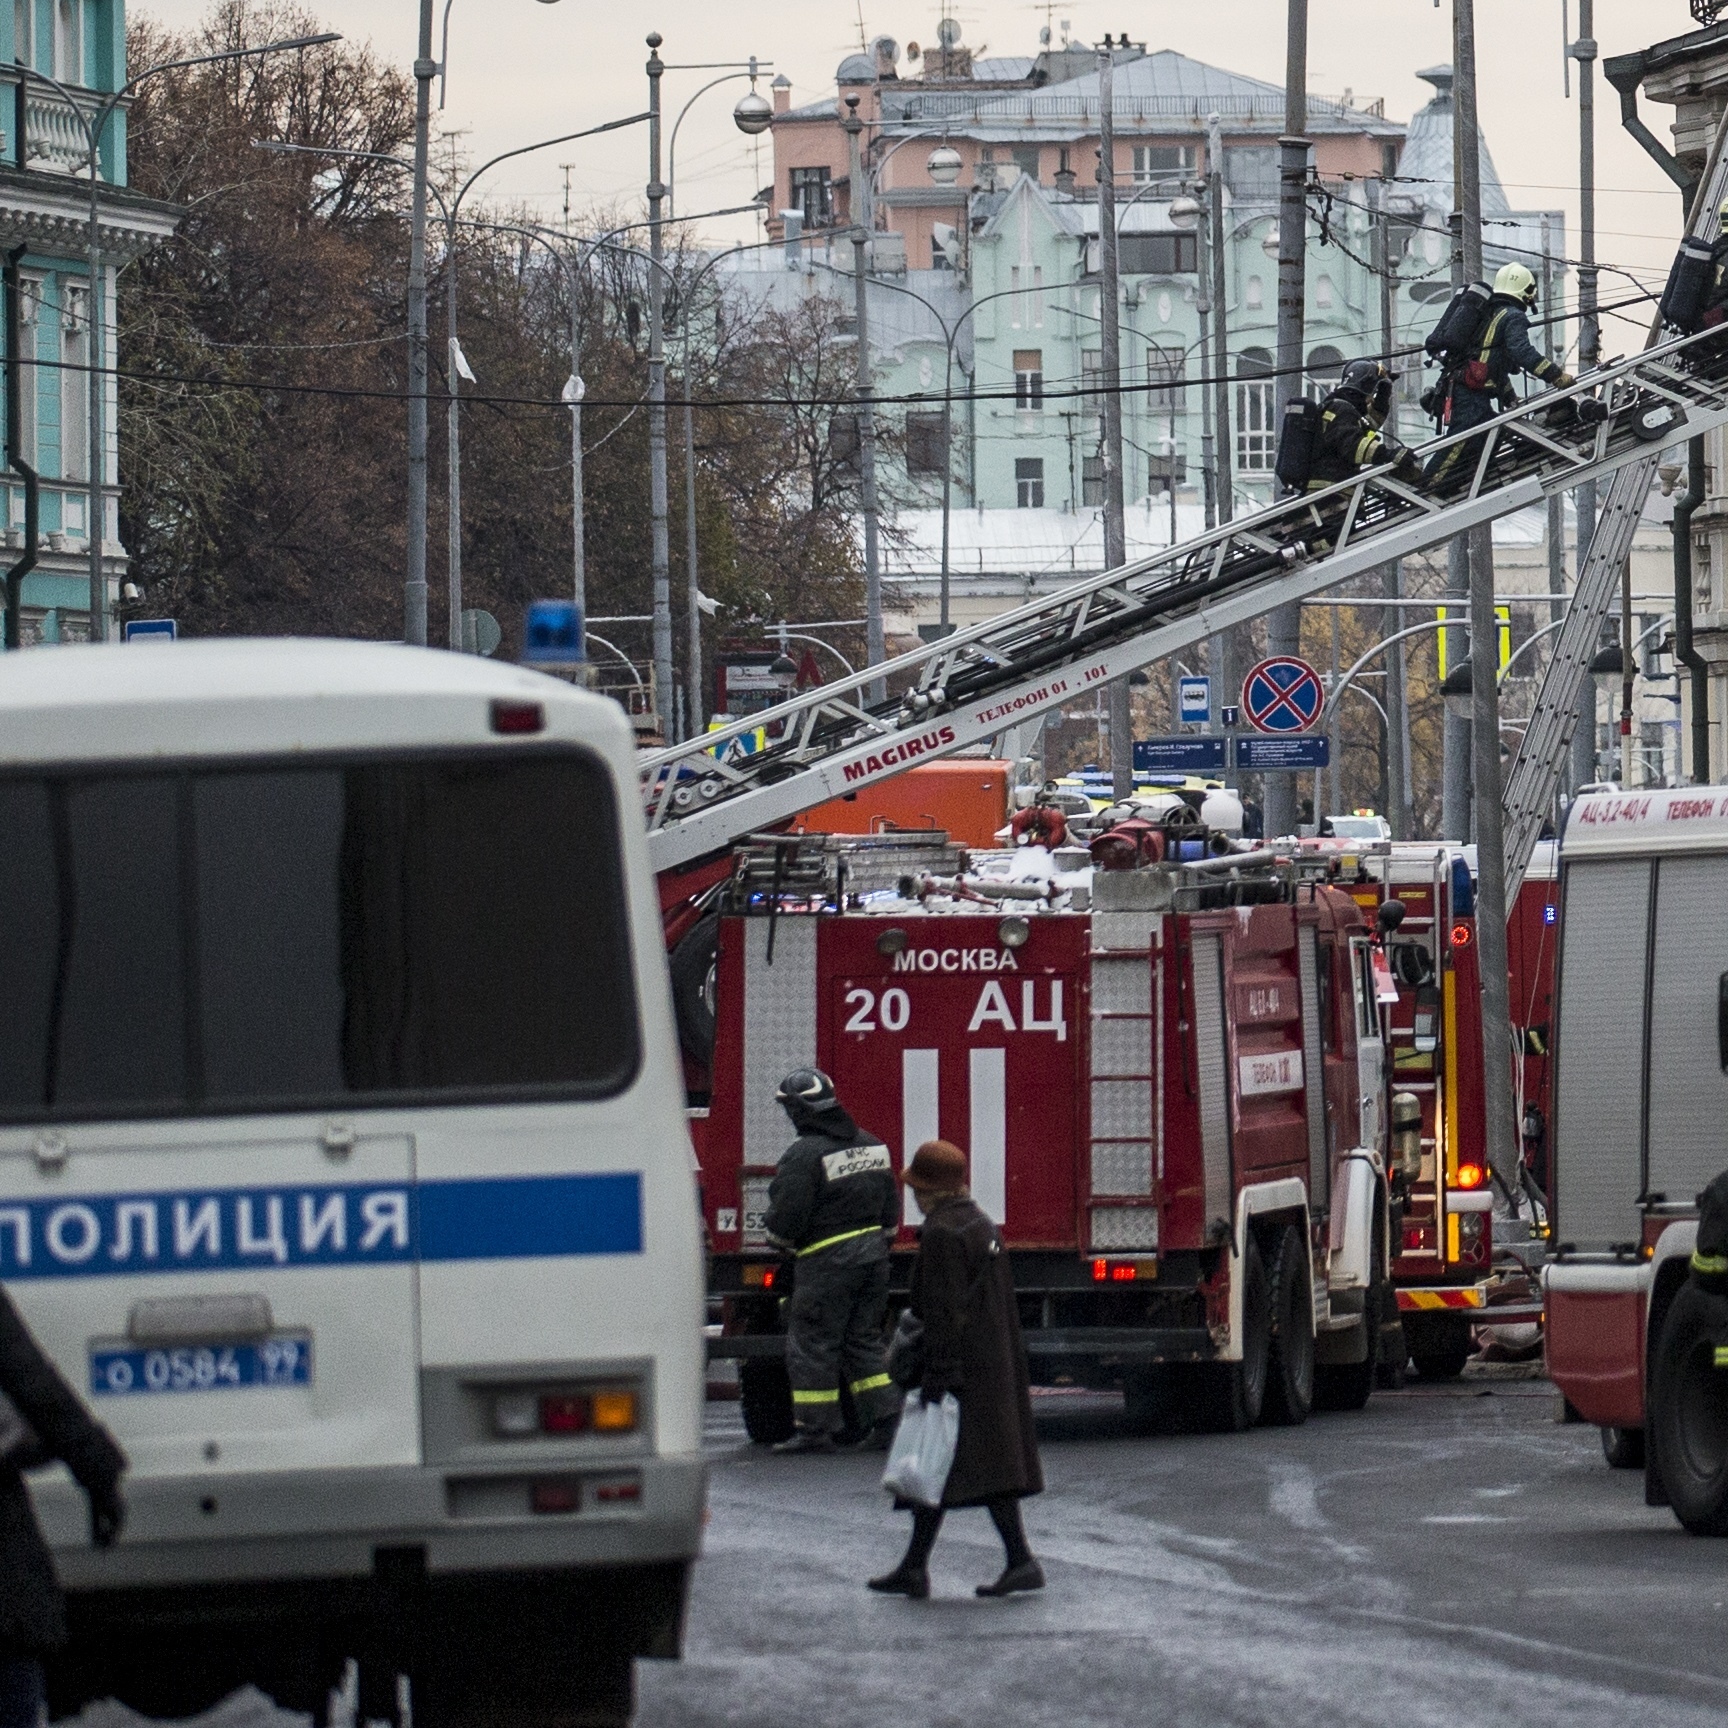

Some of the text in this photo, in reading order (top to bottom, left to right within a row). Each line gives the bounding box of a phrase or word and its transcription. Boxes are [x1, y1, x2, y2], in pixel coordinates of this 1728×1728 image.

[976, 688, 1049, 724] ТЕЛЕФОН
[1052, 679, 1068, 696] 01
[1084, 664, 1109, 683] 101
[842, 726, 956, 783] MAGIRUS
[1666, 797, 1715, 821] ТЕЛЕФОН
[893, 948, 1018, 972] МОСКВА
[844, 988, 911, 1032] 20
[967, 980, 1067, 1041] АЦ
[838, 1158, 885, 1175] РОССИИ
[845, 1147, 870, 1159] МЧС
[0, 1189, 410, 1267] ПОЛИЦИЯ
